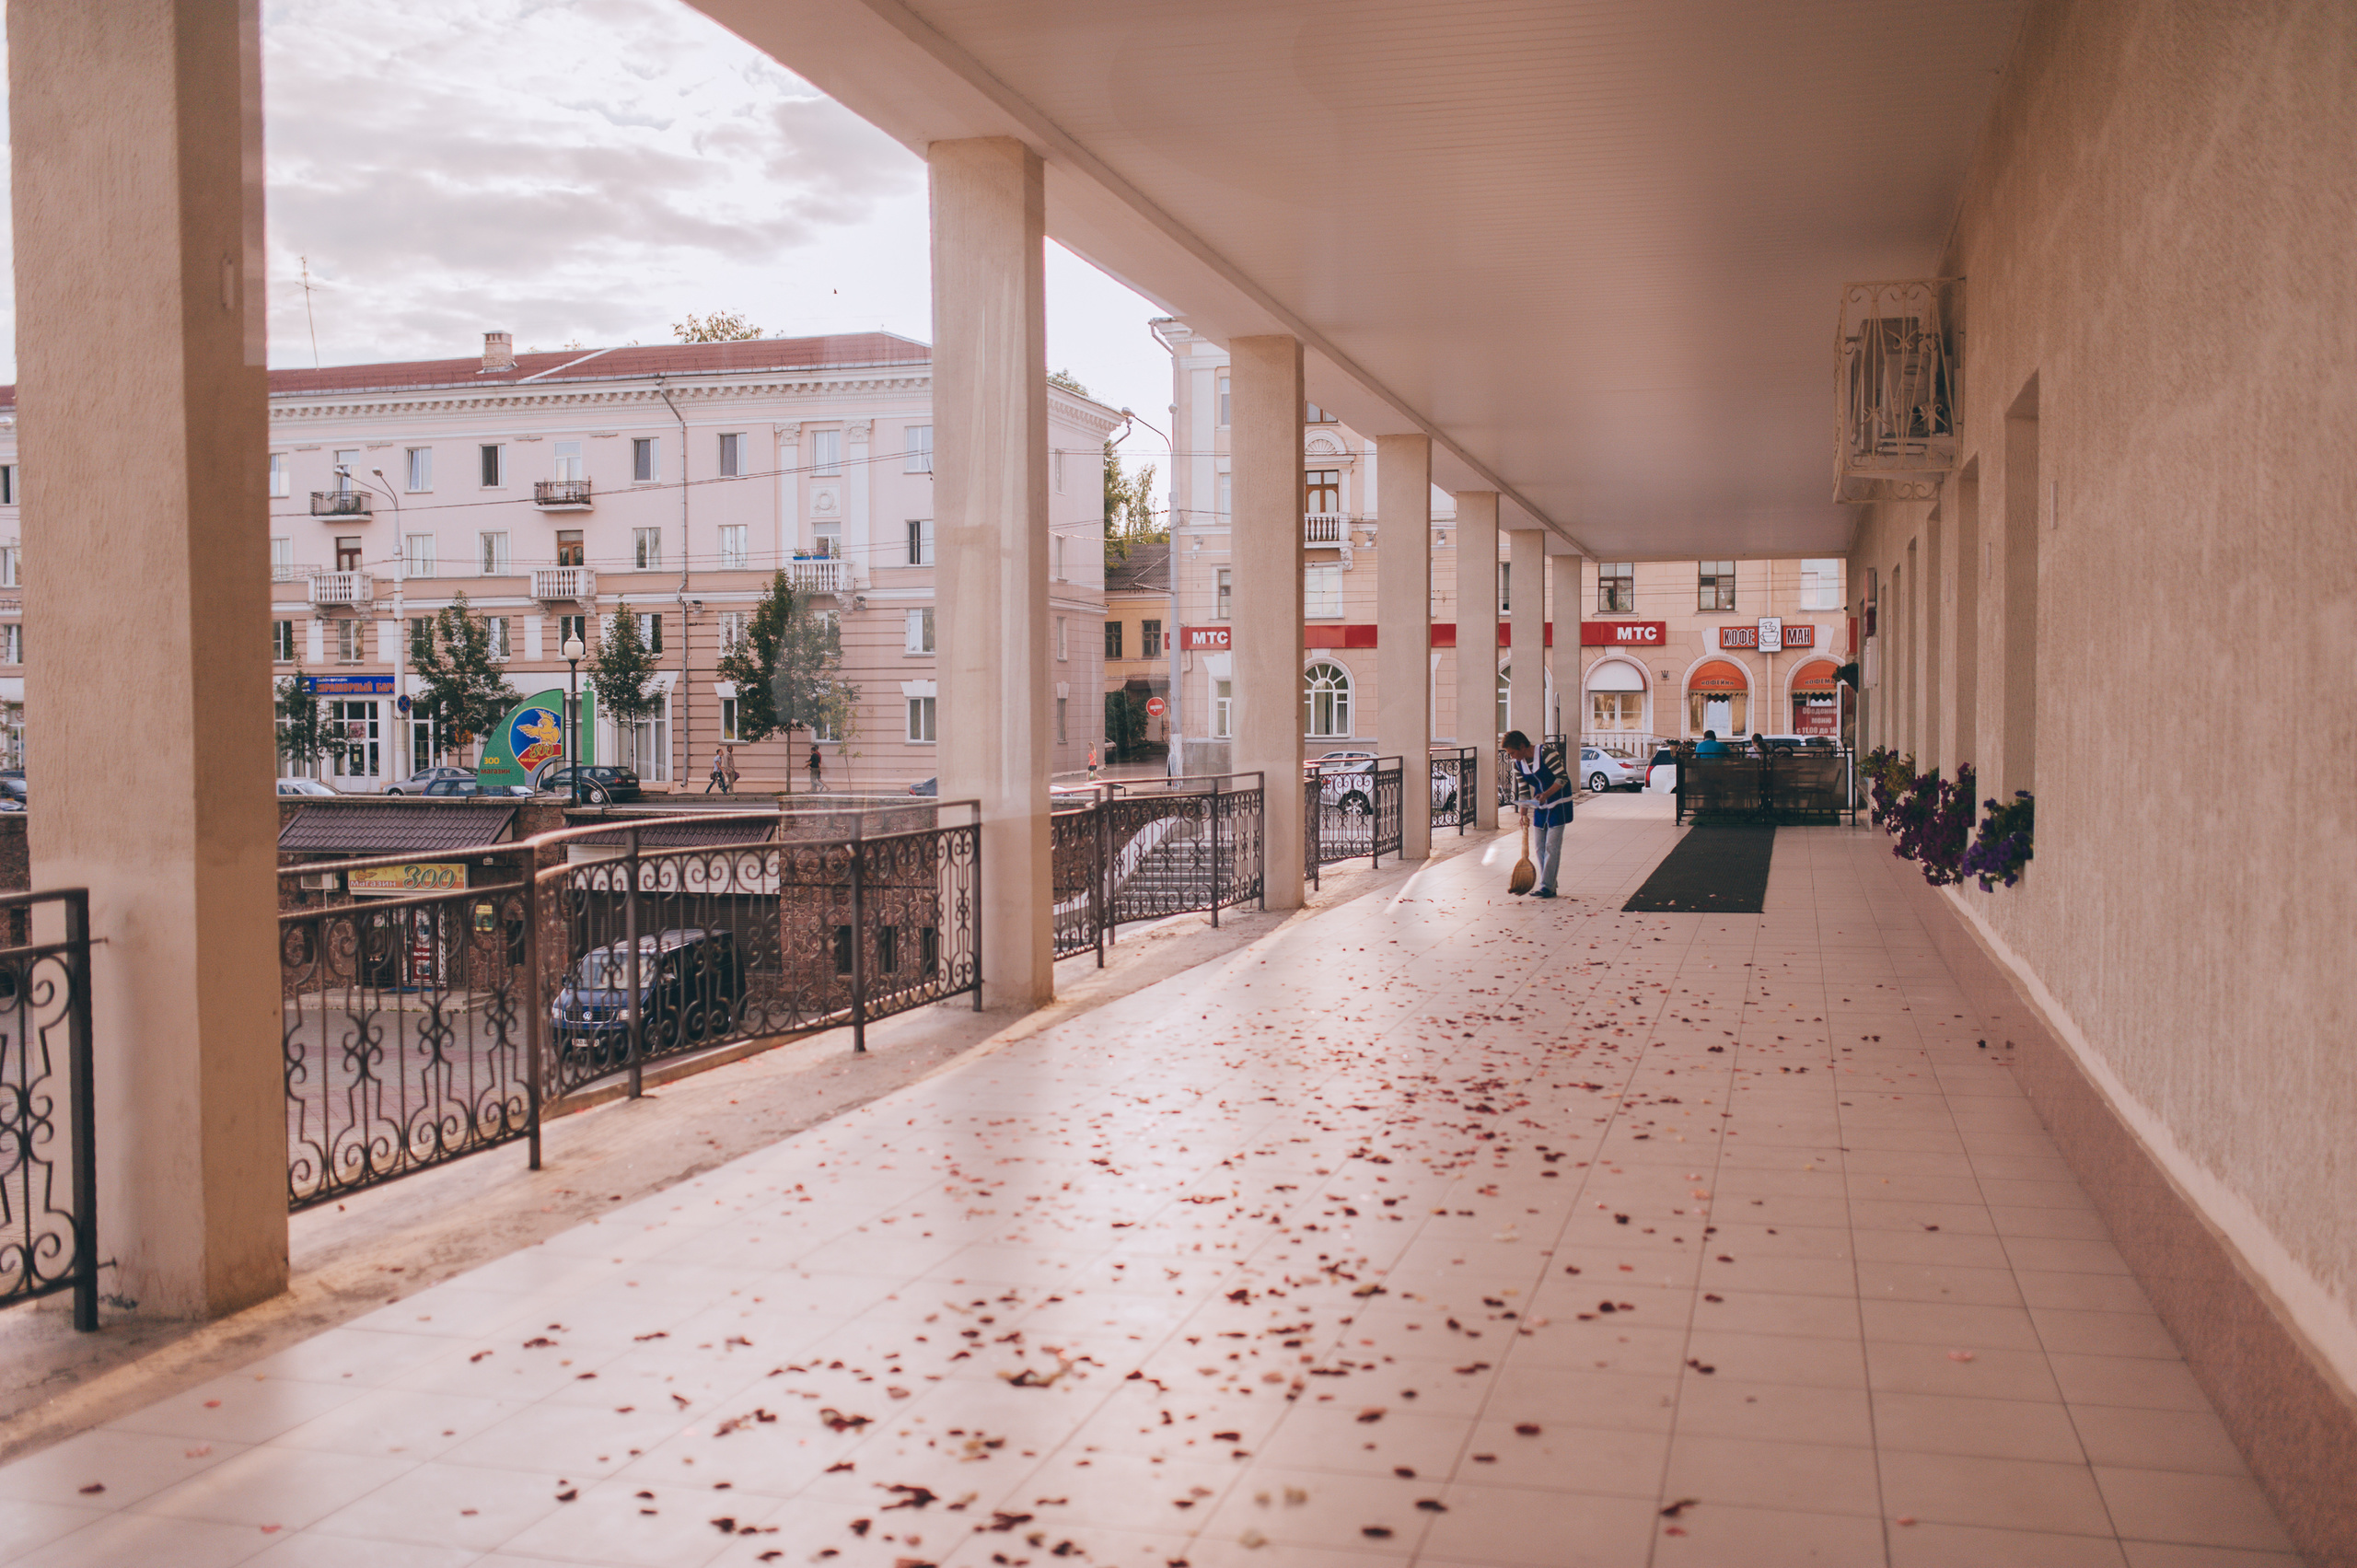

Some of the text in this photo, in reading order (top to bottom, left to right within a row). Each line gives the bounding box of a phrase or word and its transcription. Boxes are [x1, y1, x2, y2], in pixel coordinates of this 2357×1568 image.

[1192, 631, 1228, 645] МТС
[1617, 627, 1657, 641] МТС
[1724, 628, 1811, 645] КОФЕ МАН
